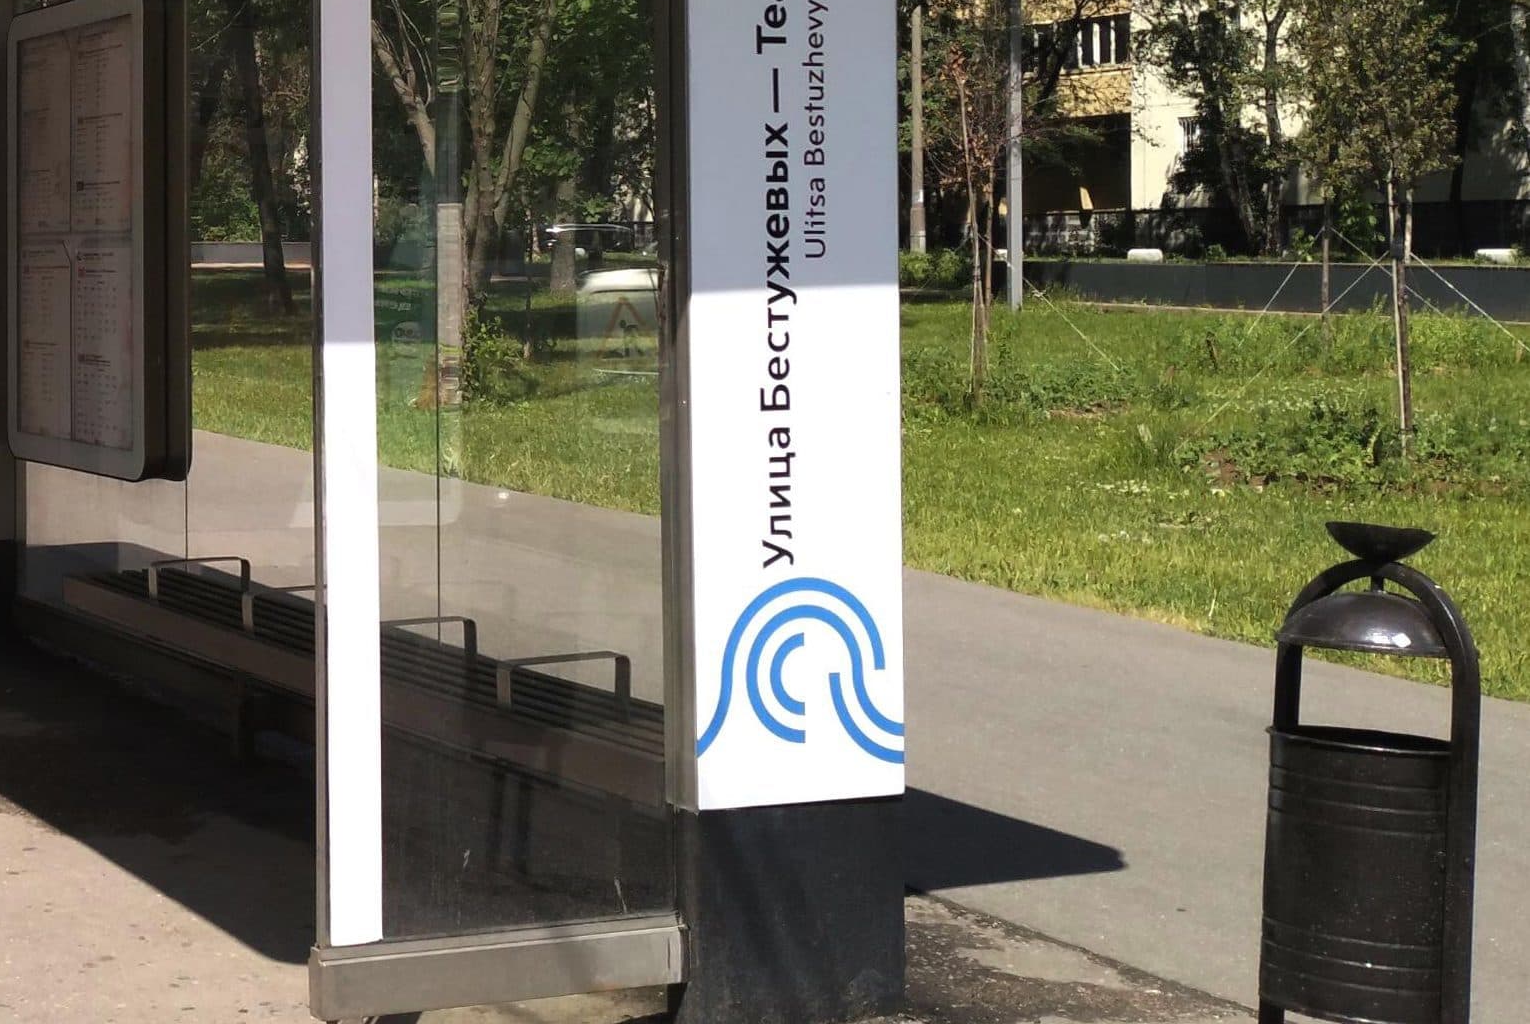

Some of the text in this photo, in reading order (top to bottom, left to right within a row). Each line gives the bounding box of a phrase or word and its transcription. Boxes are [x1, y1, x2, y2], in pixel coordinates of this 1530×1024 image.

[760, 122, 798, 412] Бестужевых
[803, 177, 826, 259] Ulitsa
[762, 426, 796, 568] Улица
